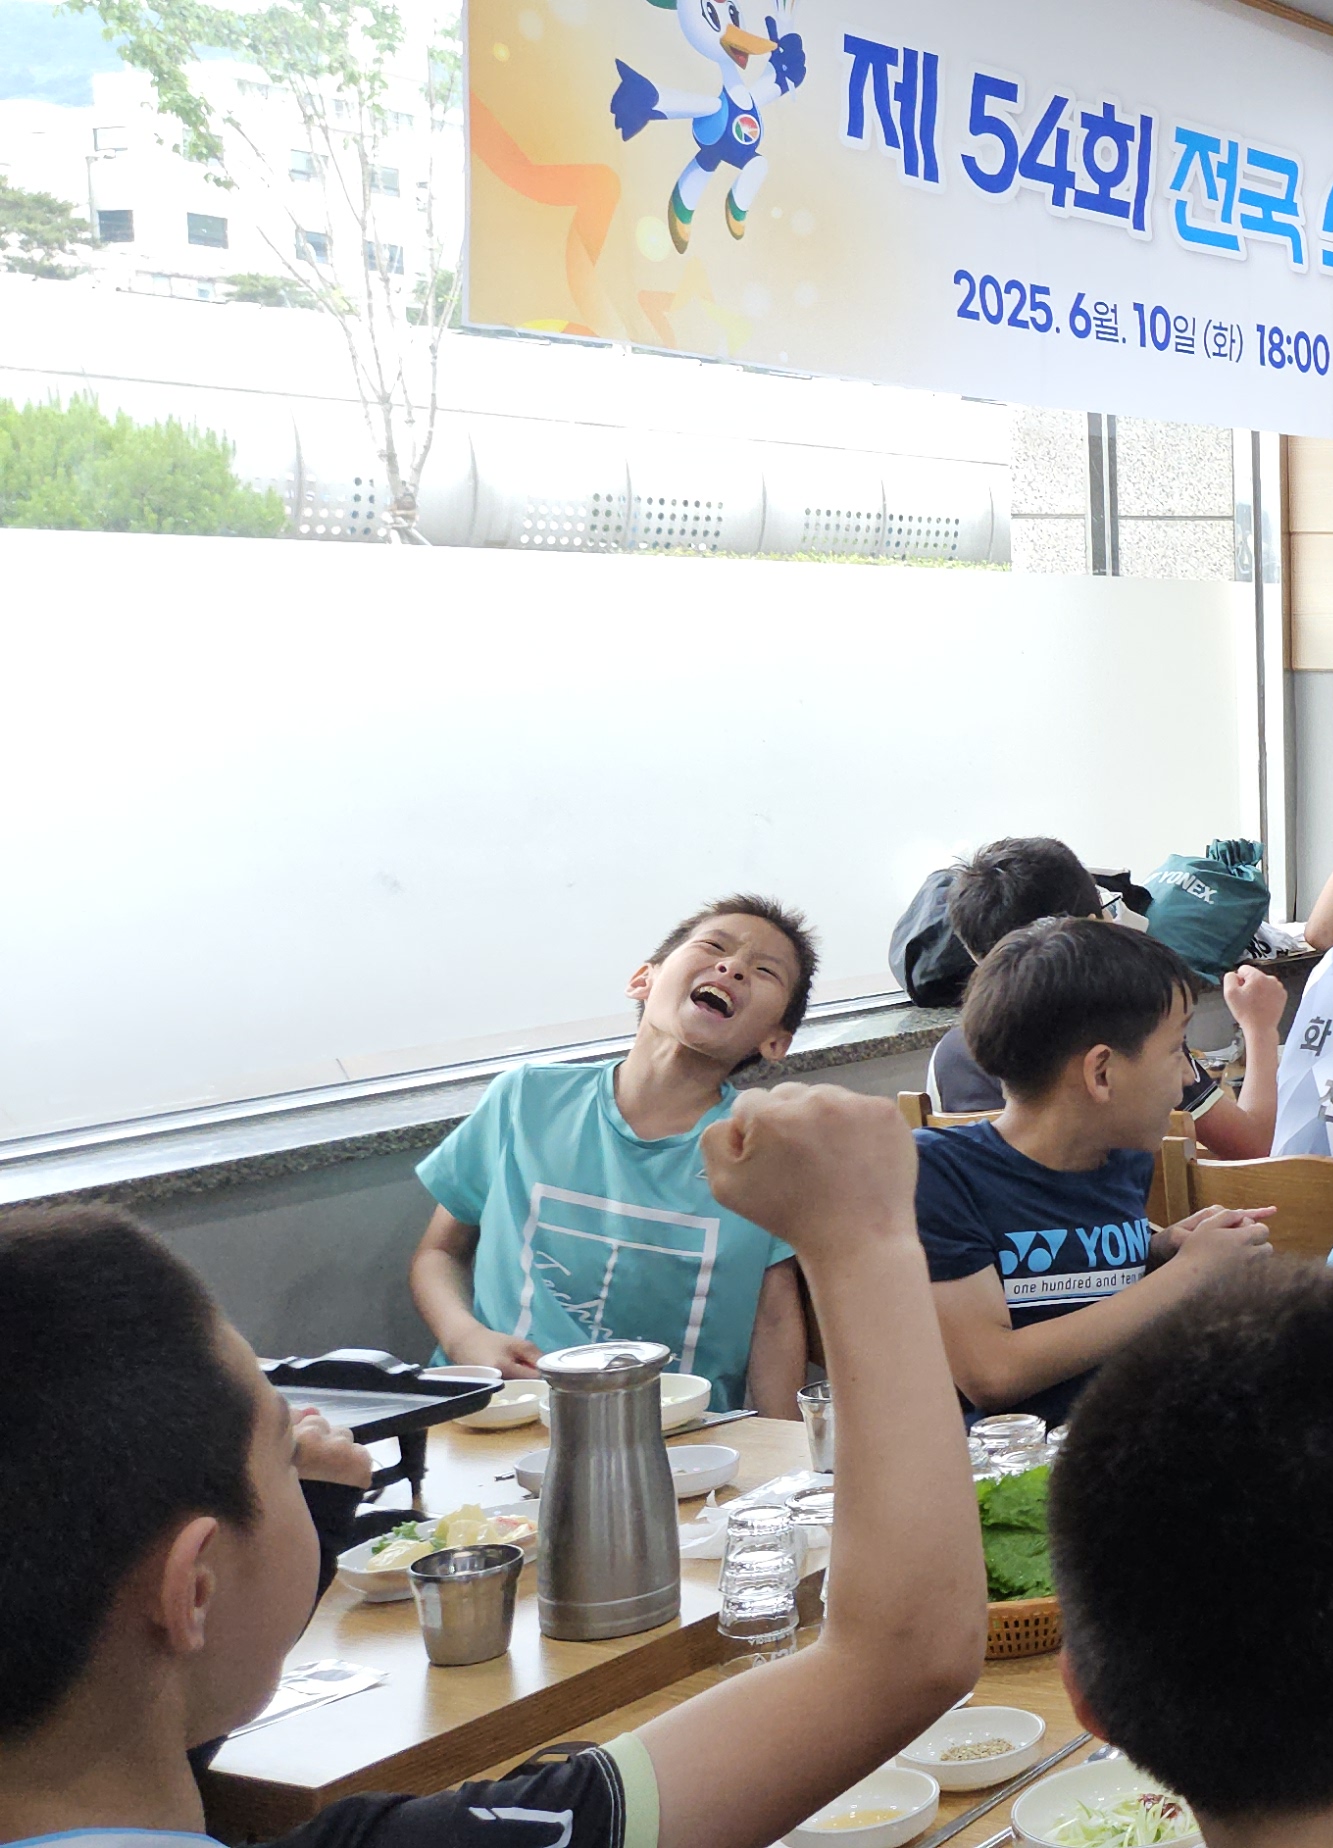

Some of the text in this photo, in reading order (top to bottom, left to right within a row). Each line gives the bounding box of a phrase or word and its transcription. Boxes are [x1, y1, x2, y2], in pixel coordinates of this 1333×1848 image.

[843, 33, 939, 184] 제
[960, 72, 1153, 233] 54회
[1167, 125, 1307, 267] 전국
[953, 268, 1331, 376] 2025. 6월. 10일 (화) 18:00
[1159, 870, 1218, 905] YONEX
[1013, 1282, 1037, 1295] one
[1041, 1276, 1092, 1292] hundred
[1096, 1273, 1117, 1288] and
